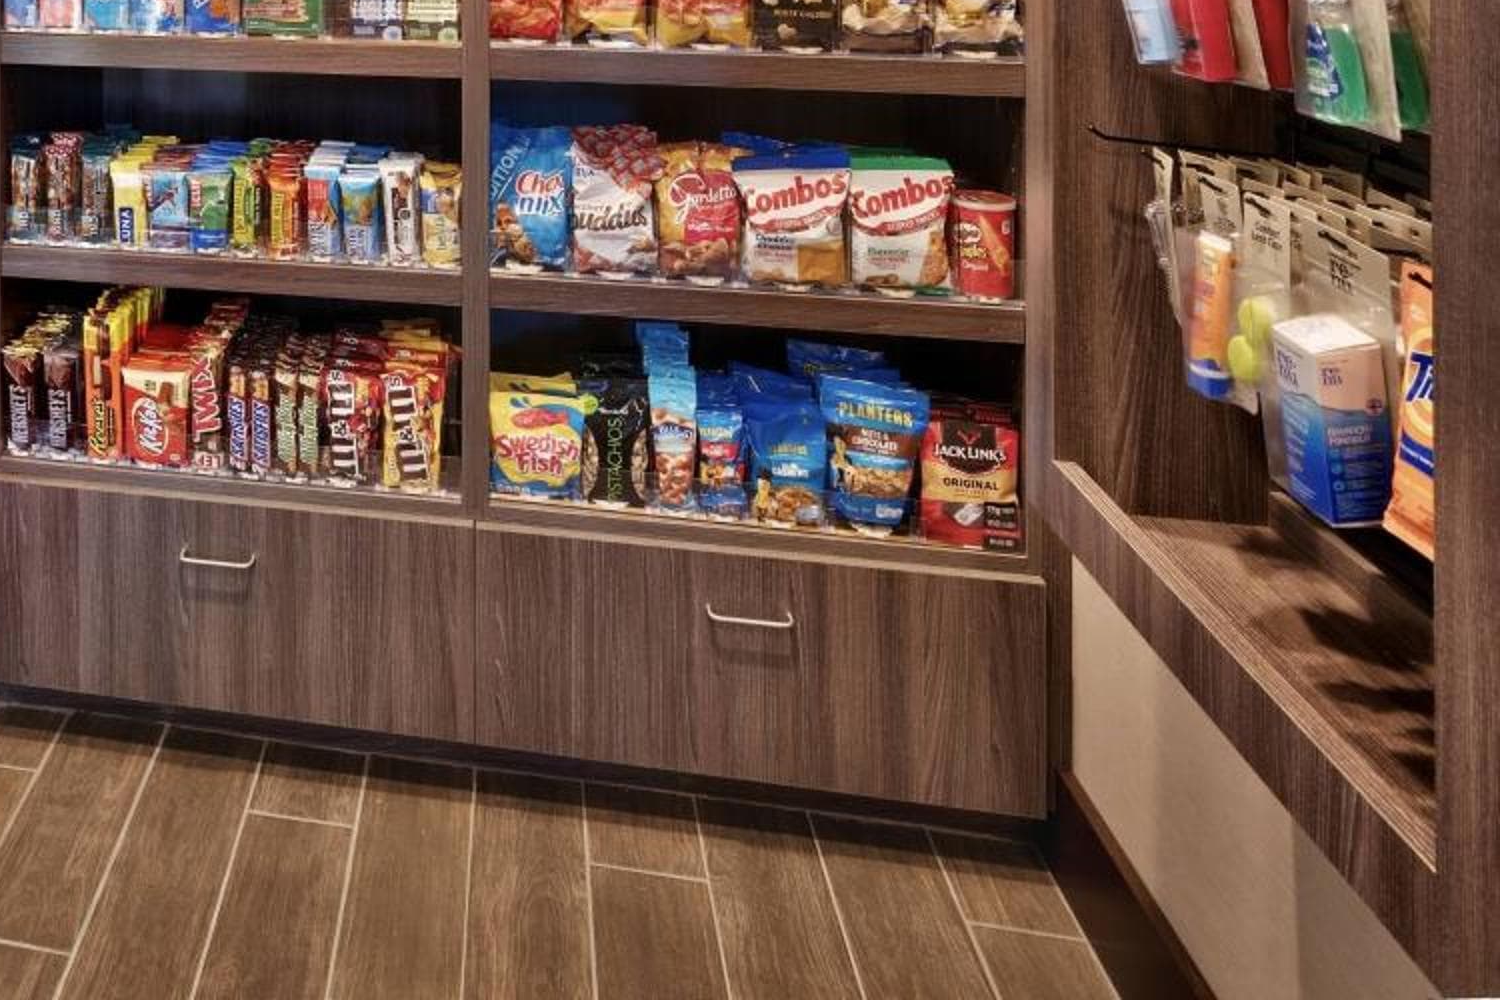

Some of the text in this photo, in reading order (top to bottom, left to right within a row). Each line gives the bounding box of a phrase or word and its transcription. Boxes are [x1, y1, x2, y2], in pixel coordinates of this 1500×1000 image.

[746, 173, 849, 216] Combos
[851, 176, 956, 219] Combos
[1404, 351, 1433, 402] Ti
[9, 384, 29, 444] HERSHEY'S
[50, 388, 68, 449] HERSHEY'S
[192, 357, 223, 443] TWIX
[835, 400, 913, 427] PLANTERS
[494, 434, 582, 461] Swedish
[515, 451, 565, 475] Fish
[934, 443, 966, 460] JACK
[943, 476, 999, 491] ORIGINAL
